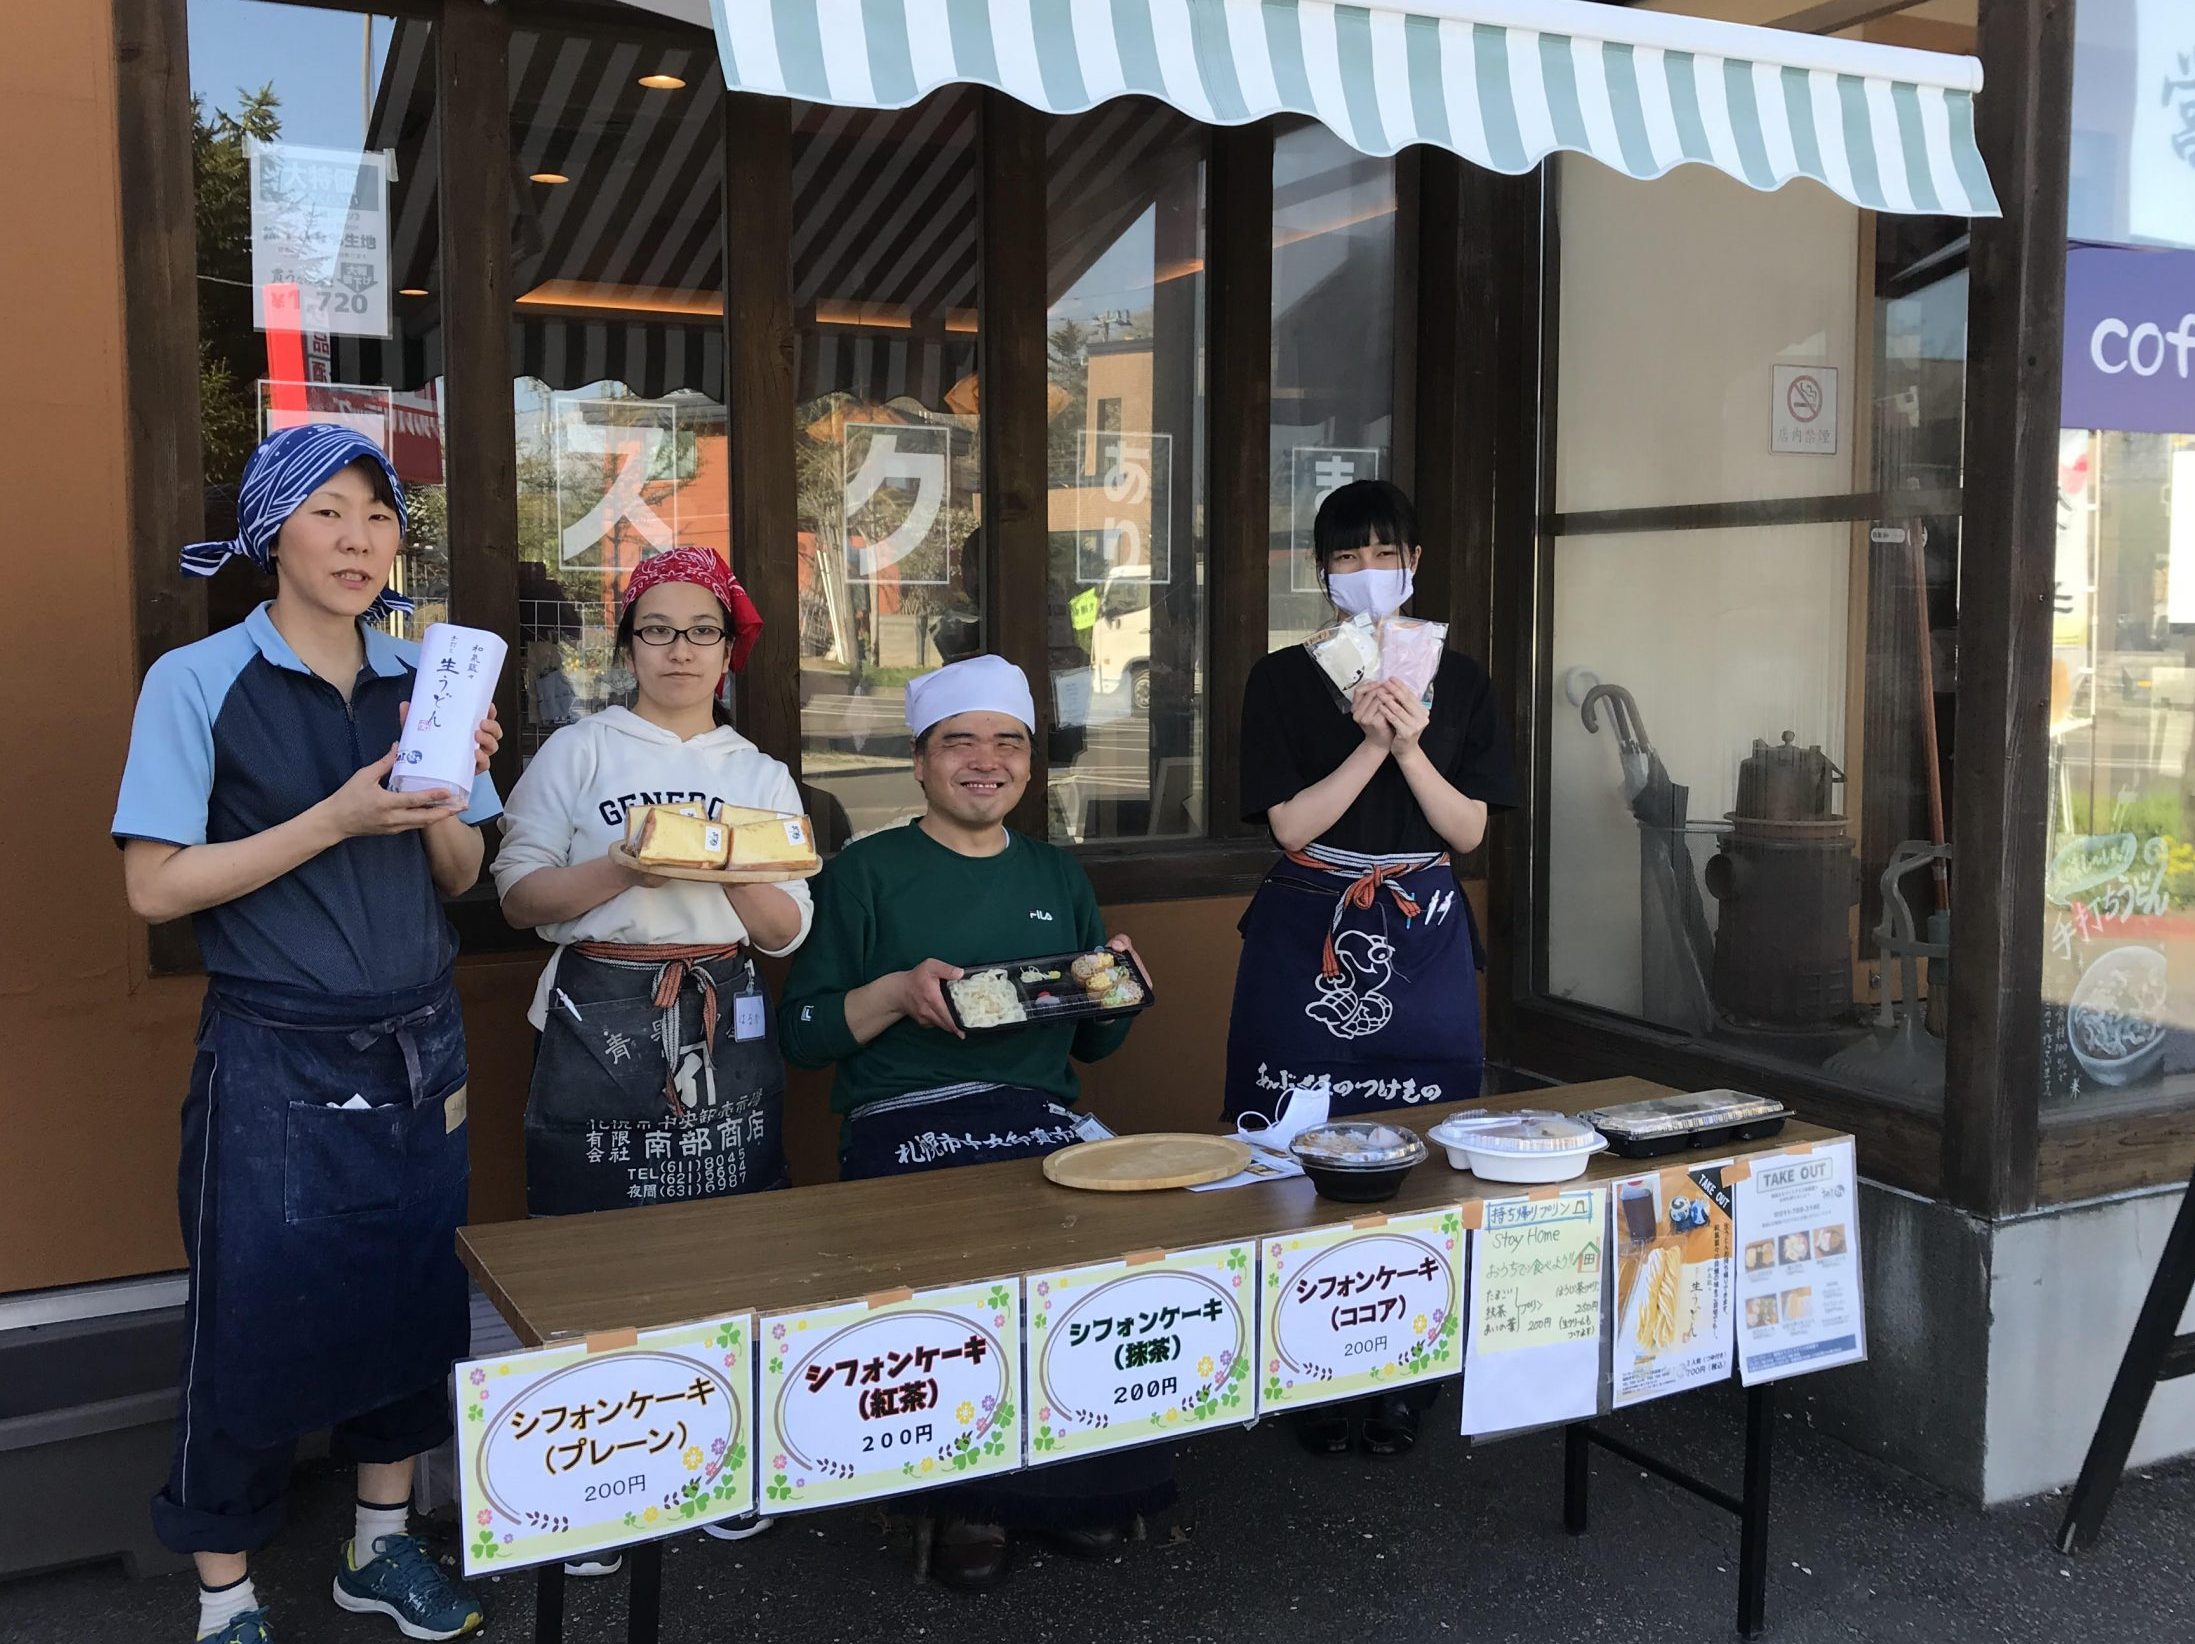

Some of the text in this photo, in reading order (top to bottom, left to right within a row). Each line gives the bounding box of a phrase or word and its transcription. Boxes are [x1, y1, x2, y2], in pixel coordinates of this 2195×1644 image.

[563, 426, 673, 561] ス
[845, 435, 944, 576] ク
[428, 657, 460, 728] 生うどん
[1030, 909, 1053, 921] FILA
[586, 1131, 631, 1148] 有限
[645, 1109, 764, 1160] 南部商店
[586, 1147, 631, 1163] 会社
[628, 1168, 659, 1180] TEL
[1763, 1163, 1827, 1188] TAKE OUT
[1698, 1174, 1730, 1209] TAKE OUT
[1491, 1202, 1570, 1224] 持ち帰りプリン
[1493, 1226, 1560, 1253] Stay Home
[1297, 1256, 1440, 1304] シフォンケーキ
[1069, 1298, 1223, 1347] シフォンケーキ
[1528, 1318, 1551, 1331] 200円
[1344, 1336, 1387, 1357] 200円
[804, 1333, 987, 1393] シフォンケーキ
[1113, 1377, 1177, 1404] 200円
[510, 1377, 716, 1440] シフォンケーキ
[862, 1424, 933, 1453] 200円
[584, 1474, 647, 1503] 200円
